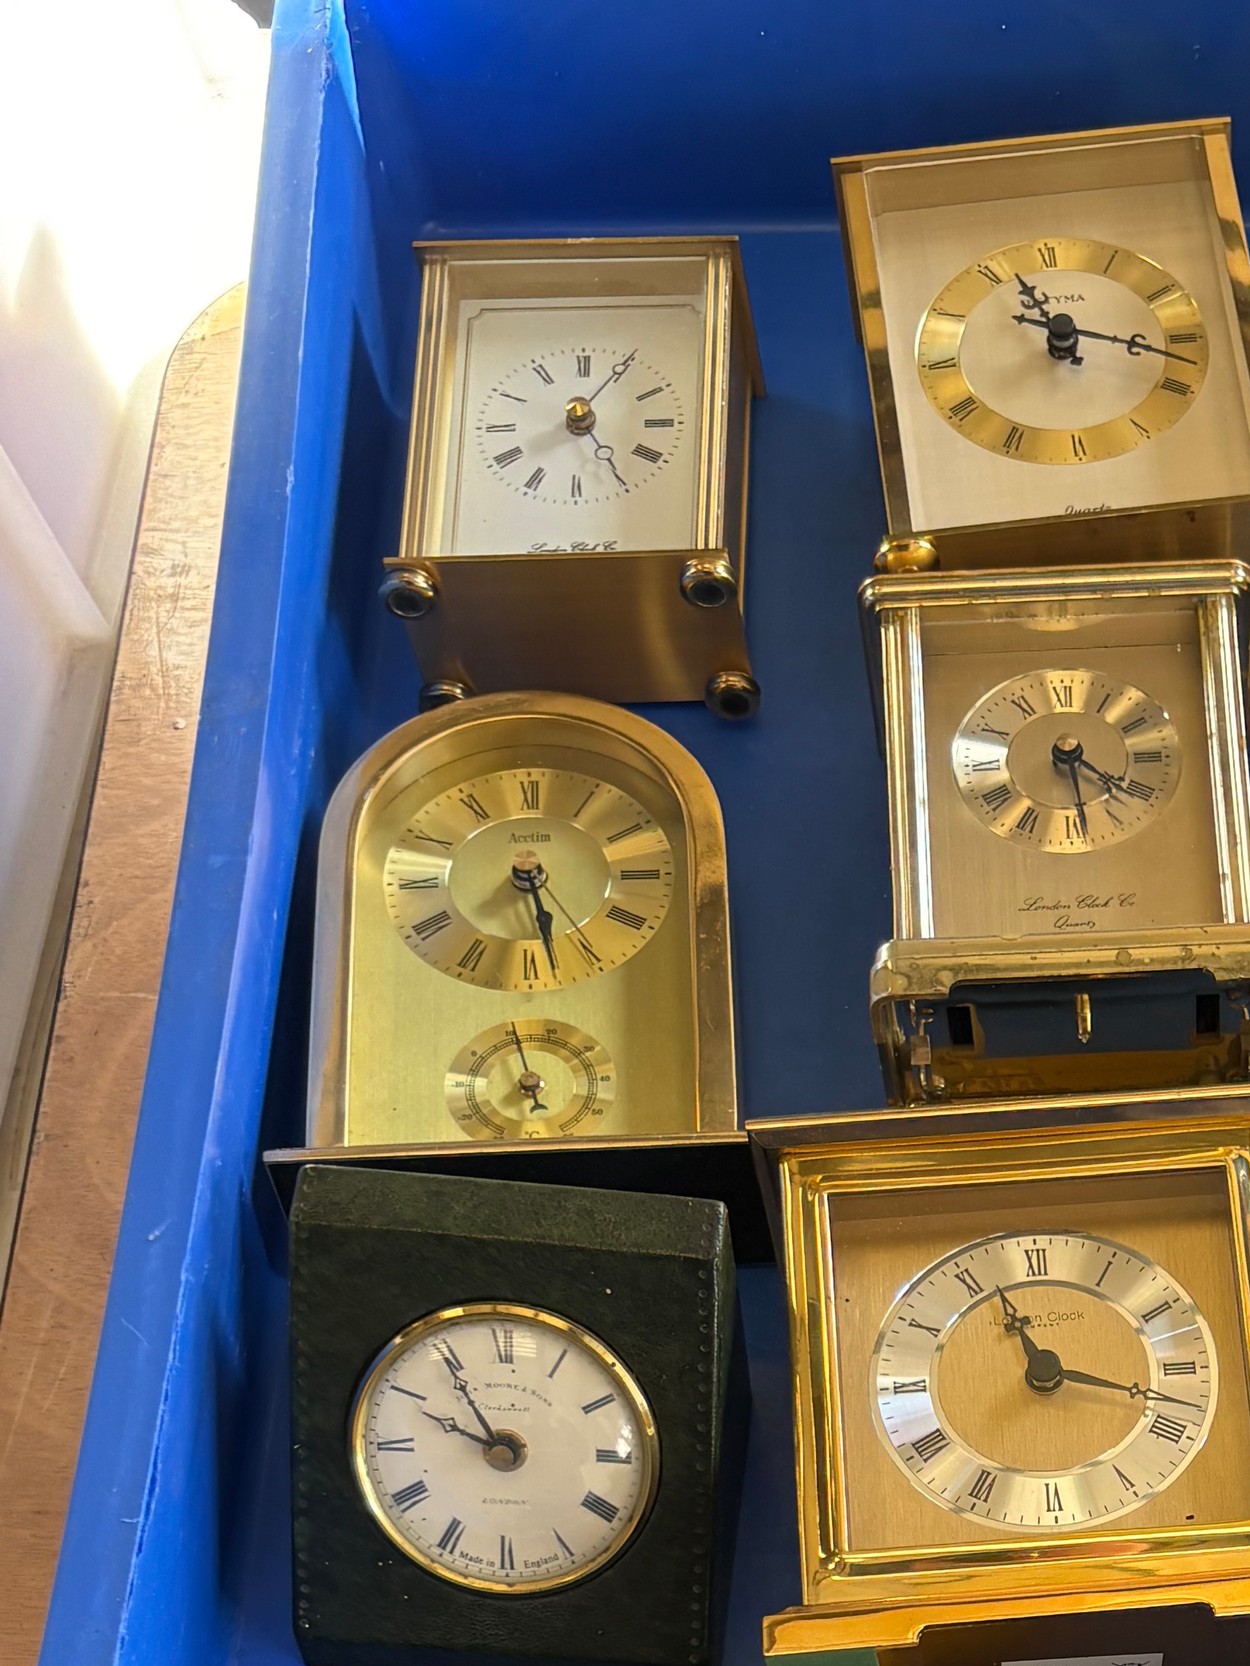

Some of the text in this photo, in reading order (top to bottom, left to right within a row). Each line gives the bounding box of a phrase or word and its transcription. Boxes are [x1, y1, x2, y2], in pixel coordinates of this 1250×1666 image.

[1037, 246, 1058, 269] XII
[1169, 333, 1198, 344] III
[1052, 686, 1073, 708] XII
[1133, 751, 1162, 763] III
[519, 781, 539, 810] XII
[507, 832, 551, 844] Acctim
[607, 823, 643, 843] II
[620, 869, 660, 880] III
[1018, 896, 1071, 912] London
[1075, 894, 1114, 909] Clock
[1024, 1249, 1049, 1277] XII
[1047, 1310, 1085, 1323] Clock
[1141, 1301, 1173, 1323] II
[1163, 1361, 1196, 1376] III
[581, 1393, 616, 1415] II
[458, 1550, 560, 1569] Made in England
